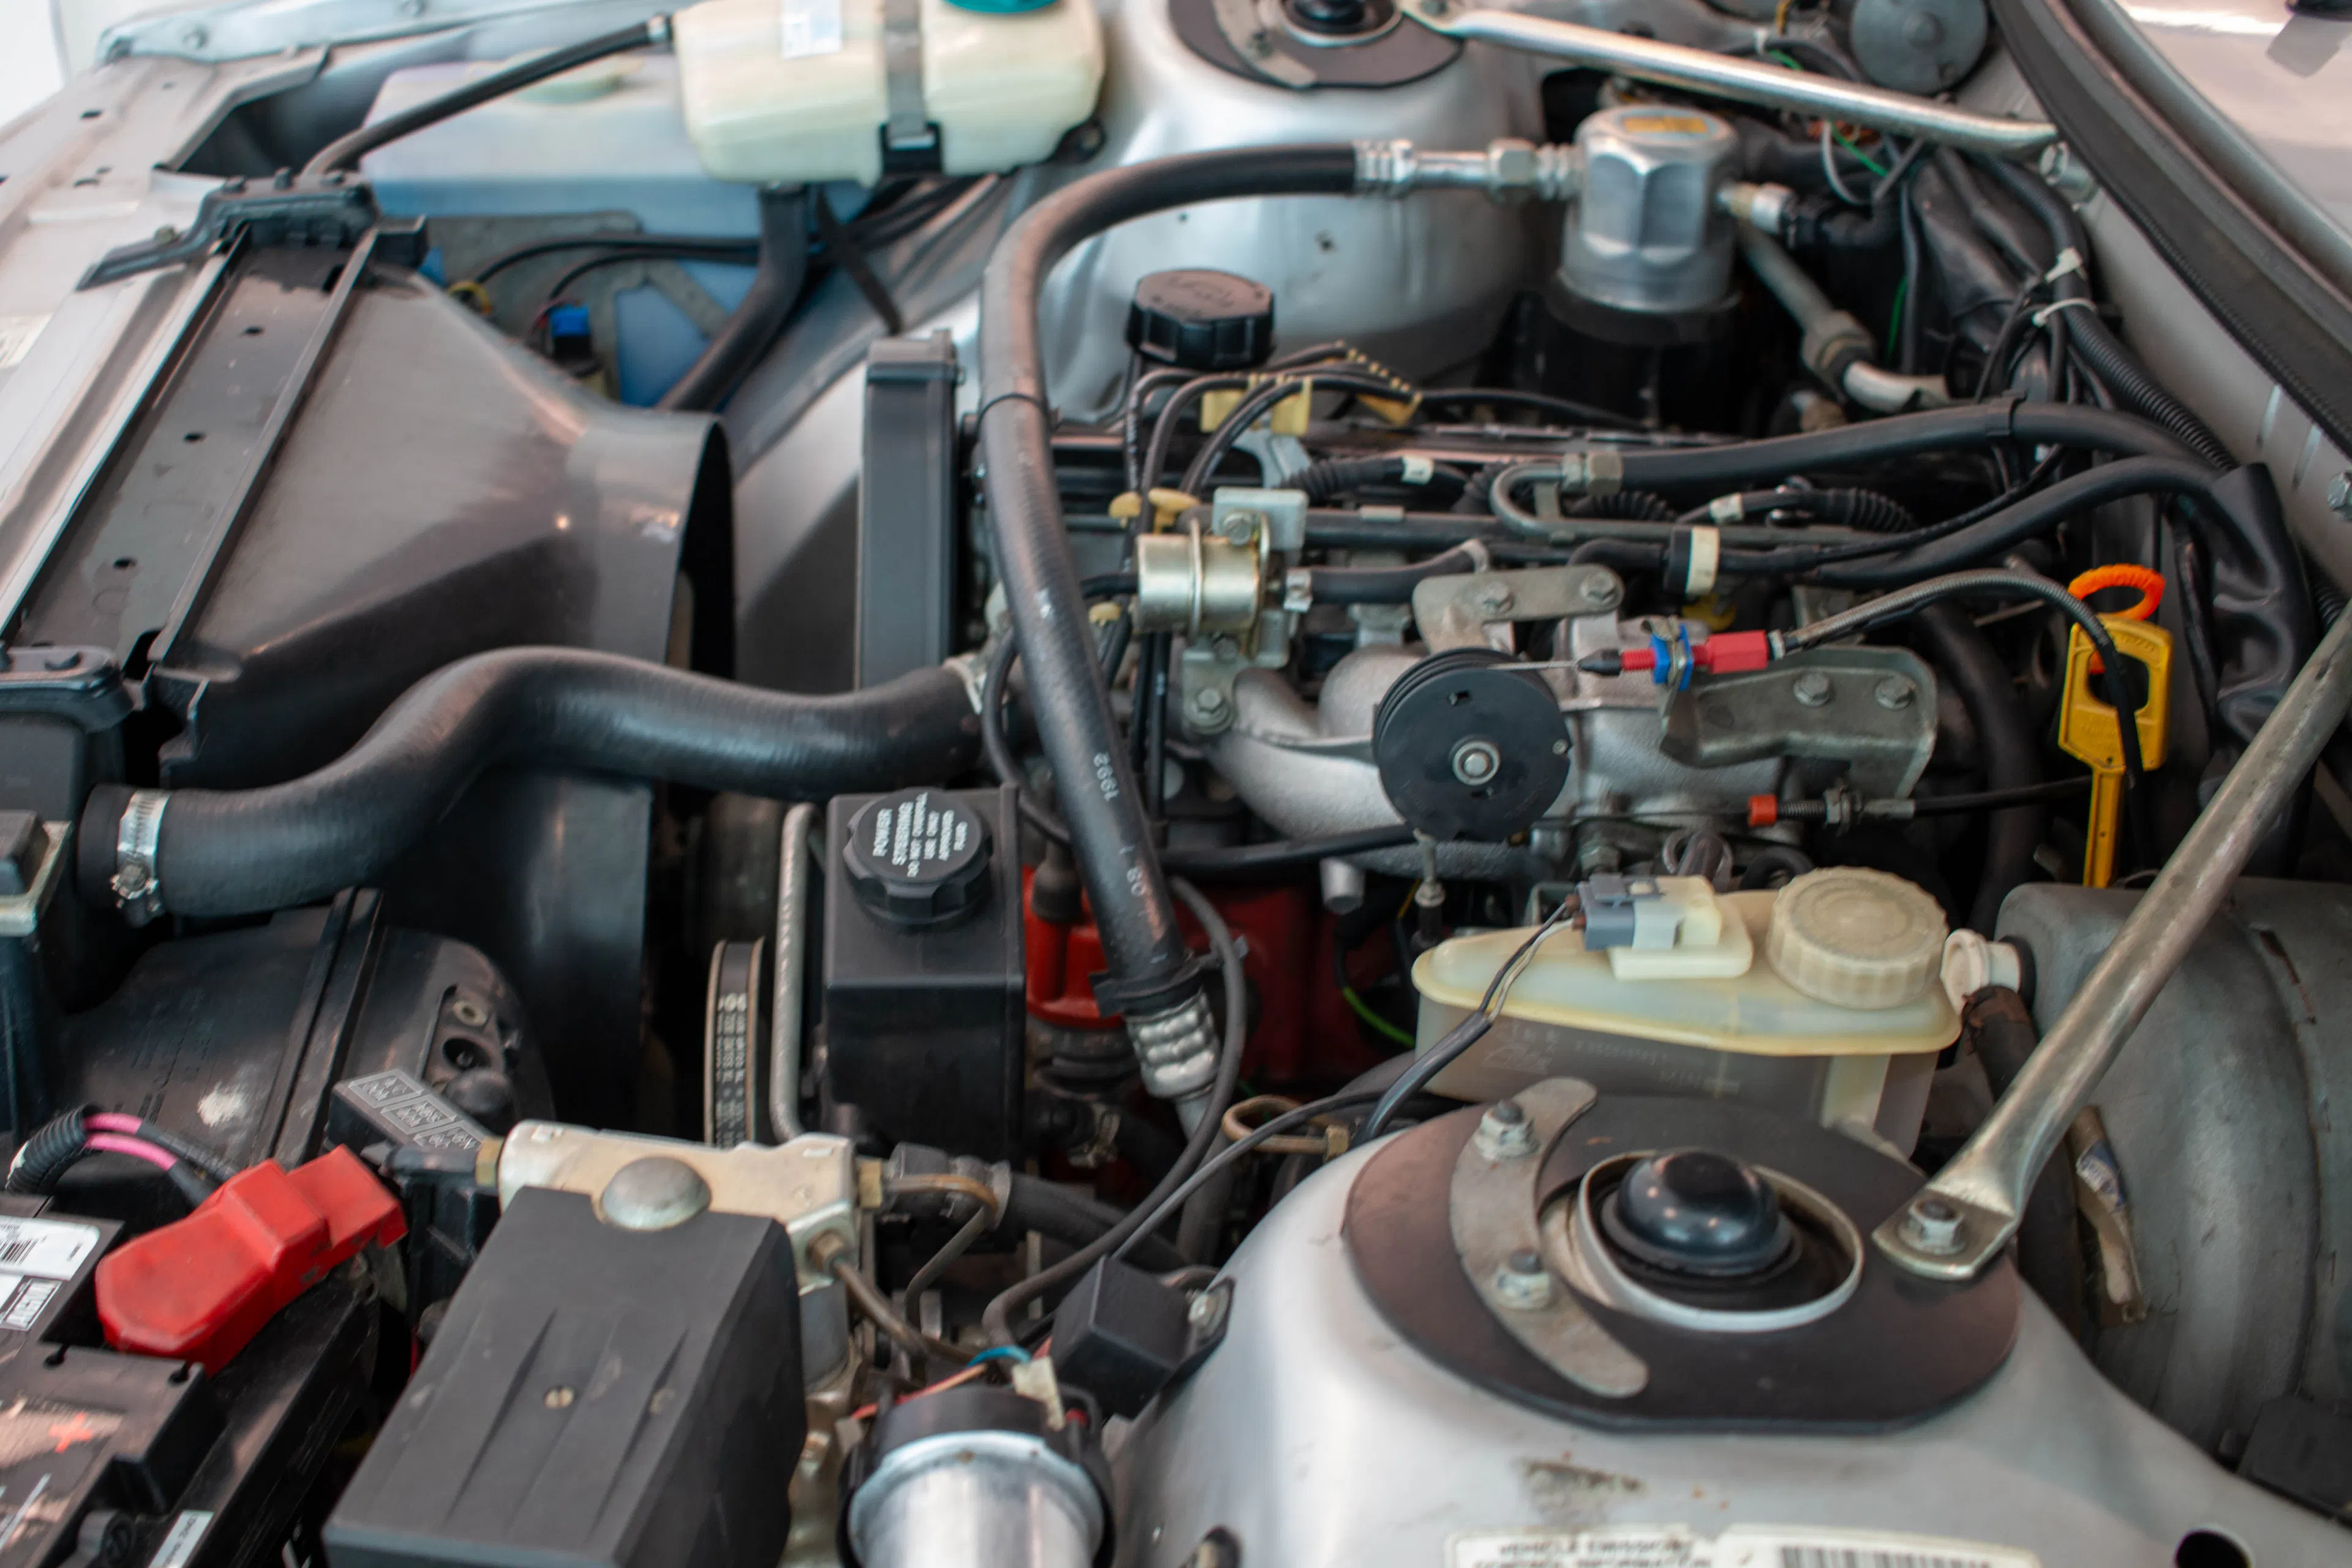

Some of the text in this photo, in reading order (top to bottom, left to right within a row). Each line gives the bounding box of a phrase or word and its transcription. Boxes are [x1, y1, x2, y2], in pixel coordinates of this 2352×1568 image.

[1093, 751, 1120, 802] 1992
[872, 809, 892, 857] POWER
[892, 802, 913, 865] STEERING
[953, 821, 968, 851] FLUID
